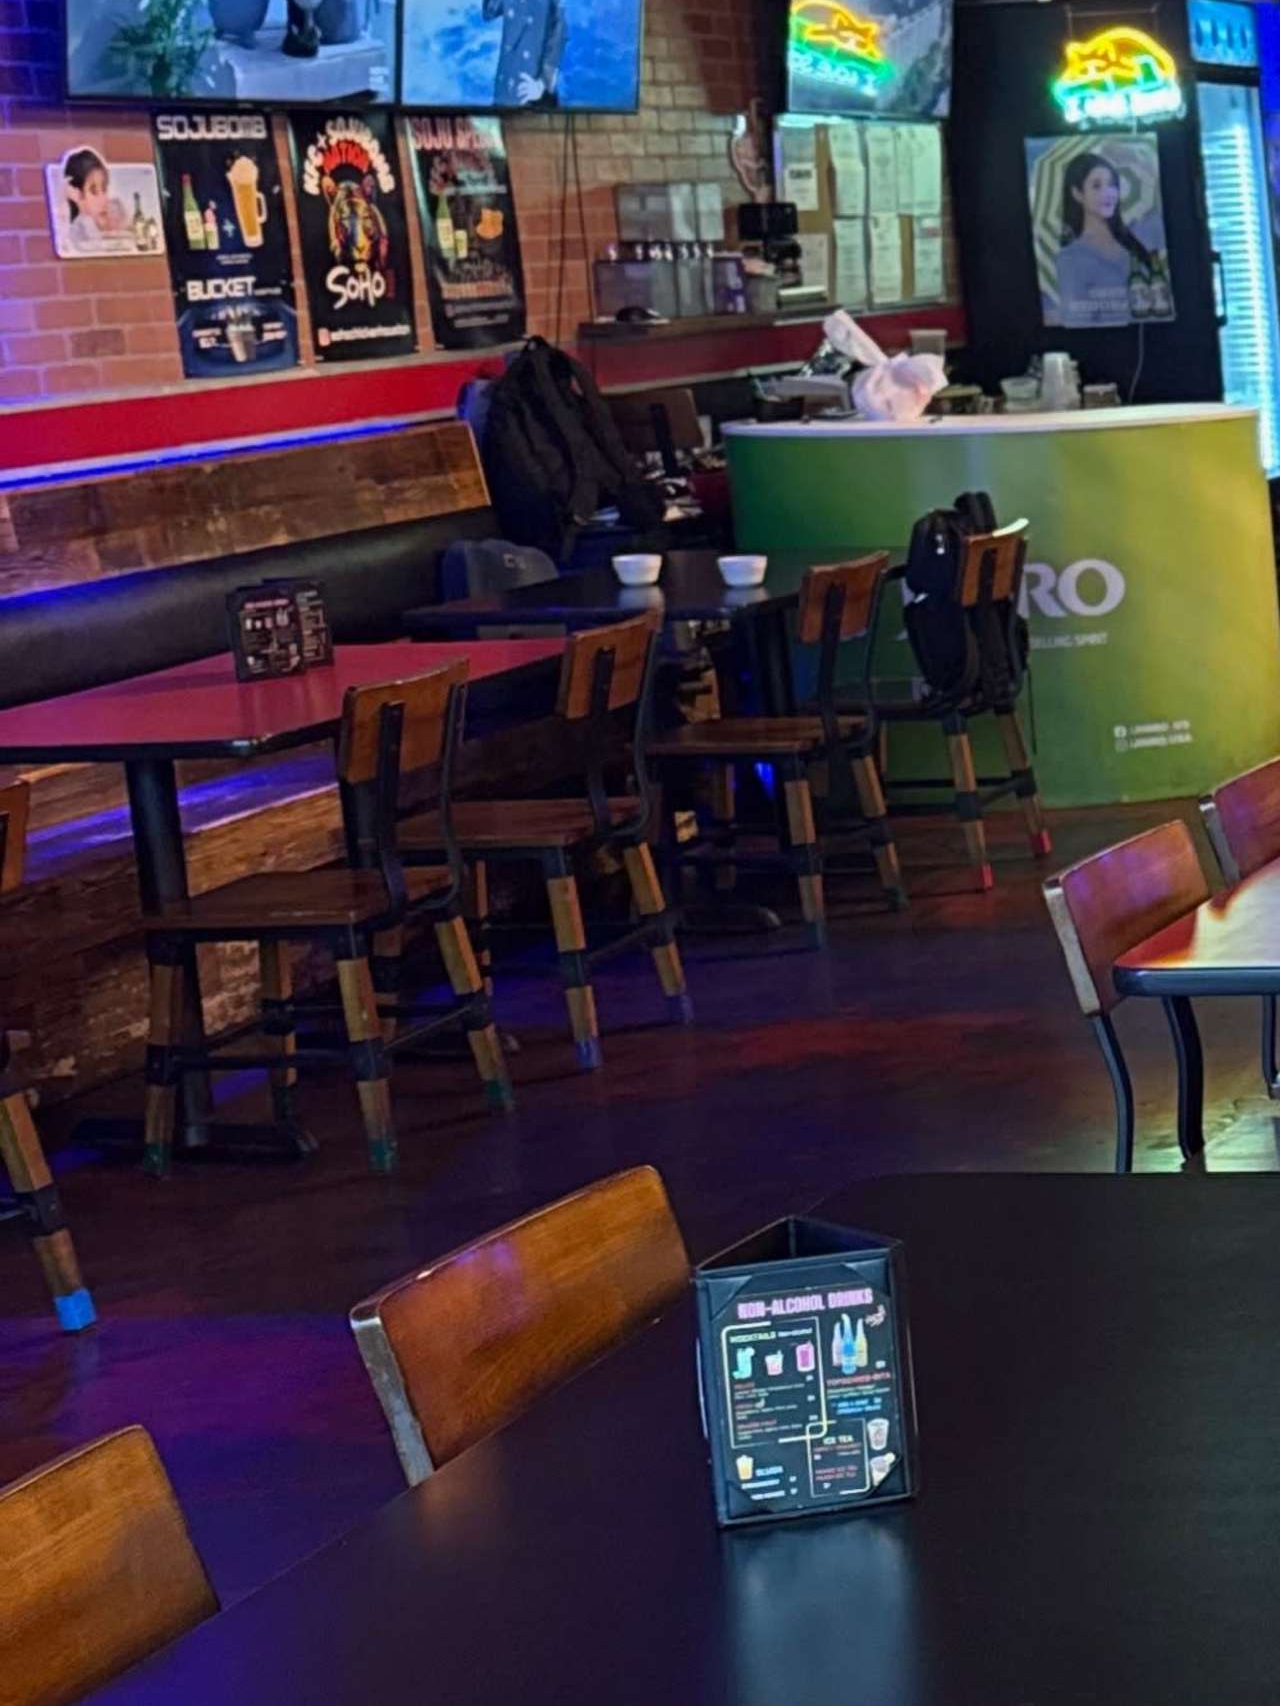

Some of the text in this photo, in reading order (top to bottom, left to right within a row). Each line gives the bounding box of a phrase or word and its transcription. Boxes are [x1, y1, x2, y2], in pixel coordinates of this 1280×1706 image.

[156, 115, 267, 140] SOJUBOMB
[187, 277, 256, 301] BUCKET
[737, 1287, 873, 1320] NON-ALCOHOL DRINKS
